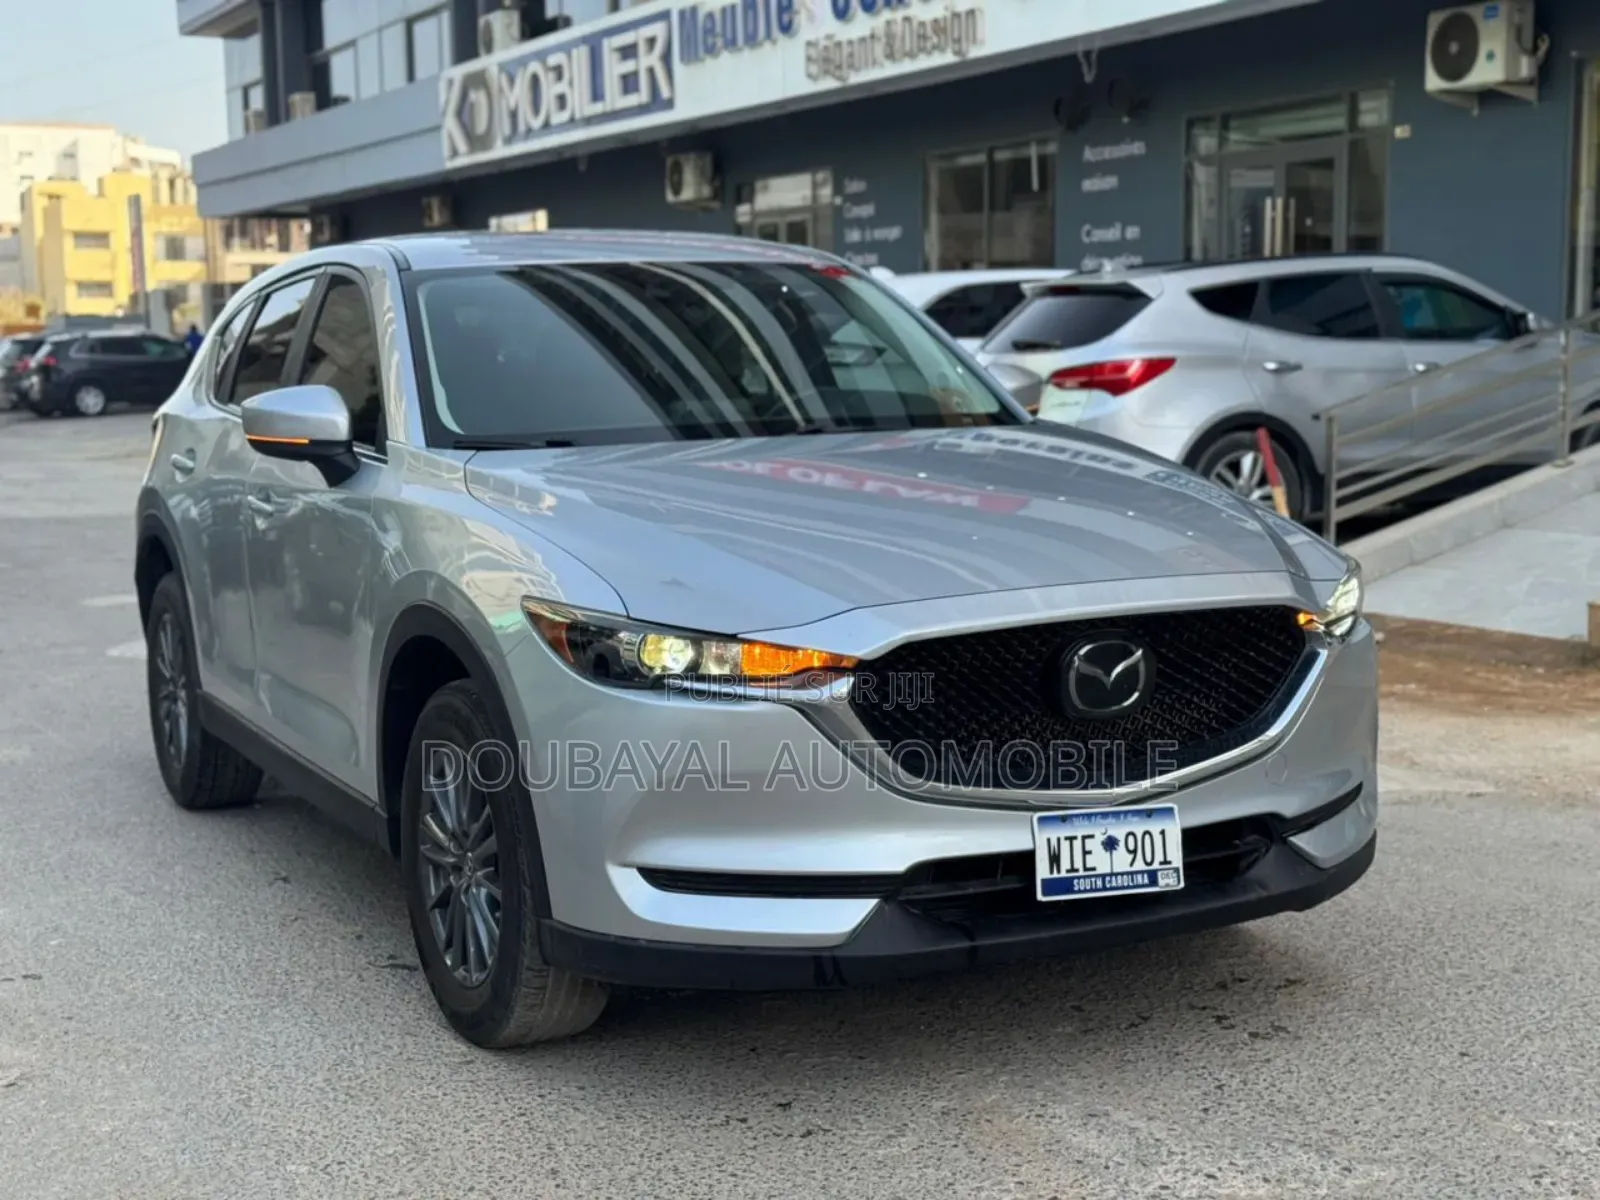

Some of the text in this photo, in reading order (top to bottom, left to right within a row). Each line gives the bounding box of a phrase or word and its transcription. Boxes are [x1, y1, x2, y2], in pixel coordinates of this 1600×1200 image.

[501, 20, 673, 136] MOBILIER
[1046, 828, 1172, 875] WIE 901
[1073, 874, 1150, 891] SOUTH CAROLINA
